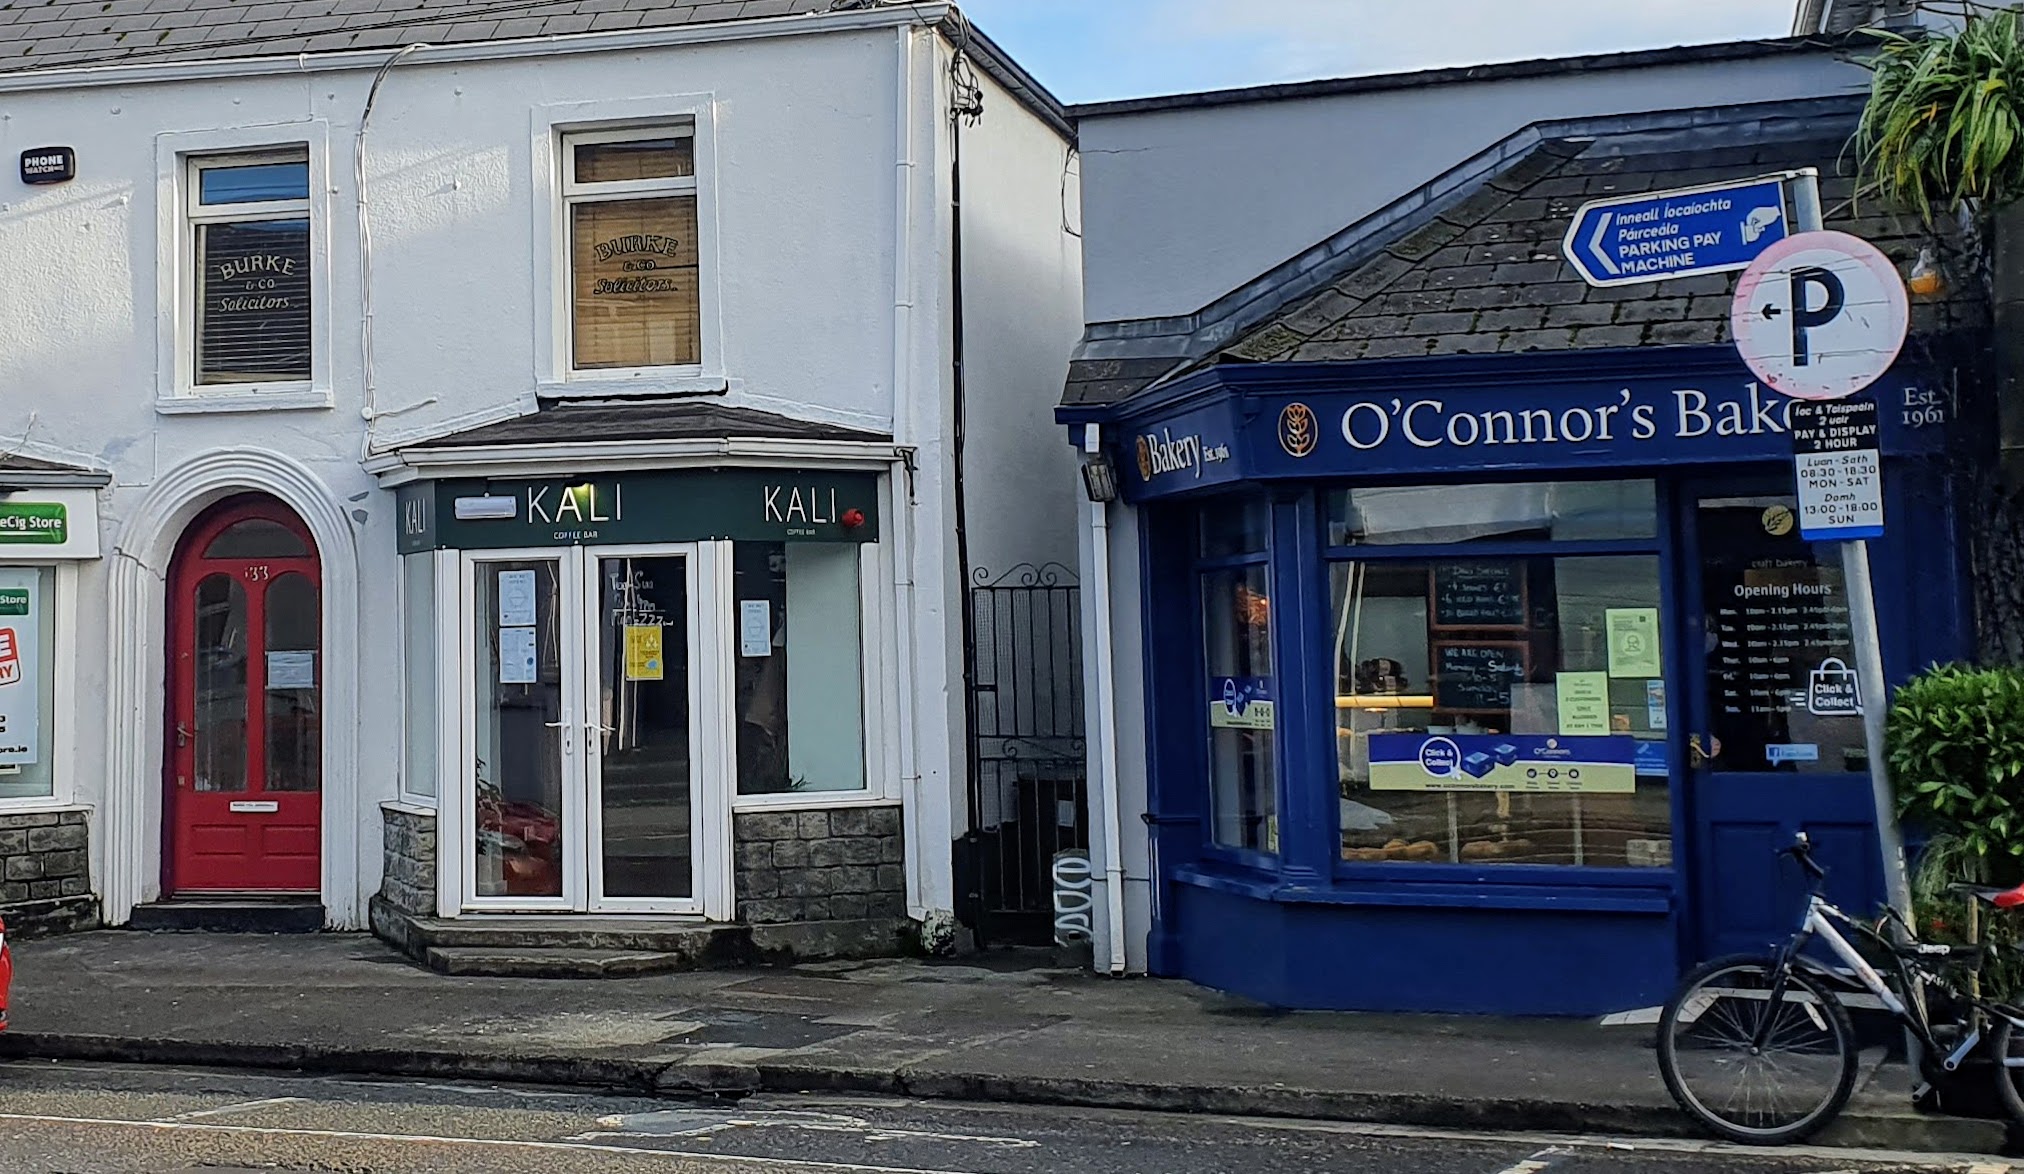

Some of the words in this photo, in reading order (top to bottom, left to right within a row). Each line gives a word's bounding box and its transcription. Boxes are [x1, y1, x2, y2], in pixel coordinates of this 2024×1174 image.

[24, 154, 64, 168] PHONE
[1616, 207, 1659, 226] Inneall
[594, 234, 679, 262] BURKE
[1618, 236, 1691, 259] PARKING
[1693, 231, 1722, 248] PAY
[220, 255, 297, 280] BURKE
[1620, 252, 1696, 275] MACHINE
[258, 279, 276, 290] CO
[218, 295, 290, 313] Solicitors
[1791, 266, 1845, 367] P
[1815, 404, 1823, 415] &
[1902, 405, 1946, 429] 1961
[1341, 388, 1656, 449] O'Connor's
[1818, 415, 1827, 426] 2
[1794, 428, 1815, 441] PAY
[1818, 428, 1827, 439] &
[1829, 424, 1877, 438] DISPLAY
[1813, 440, 1821, 450] 2
[1825, 437, 1858, 450] HOUR
[1146, 427, 1201, 479] Bakery
[1807, 457, 1833, 467] Luan
[1841, 454, 1868, 465] Sath
[1809, 479, 1837, 489] MON
[1846, 477, 1870, 487] SAT
[527, 483, 622, 524] KALI
[764, 485, 836, 524] KALI
[1824, 492, 1856, 503] Domh
[29, 515, 62, 529] Store
[405, 498, 426, 535] KALI
[1828, 514, 1855, 525] SUN
[583, 530, 598, 539] BAR
[1734, 583, 1790, 600] Opening
[1793, 582, 1832, 595] Hours
[1814, 683, 1842, 694] Click
[1844, 683, 1854, 694] &
[1814, 696, 1855, 707] Collect
[1425, 748, 1445, 757] Click
[1446, 749, 1454, 757] &
[1918, 943, 1951, 955] Jeep
